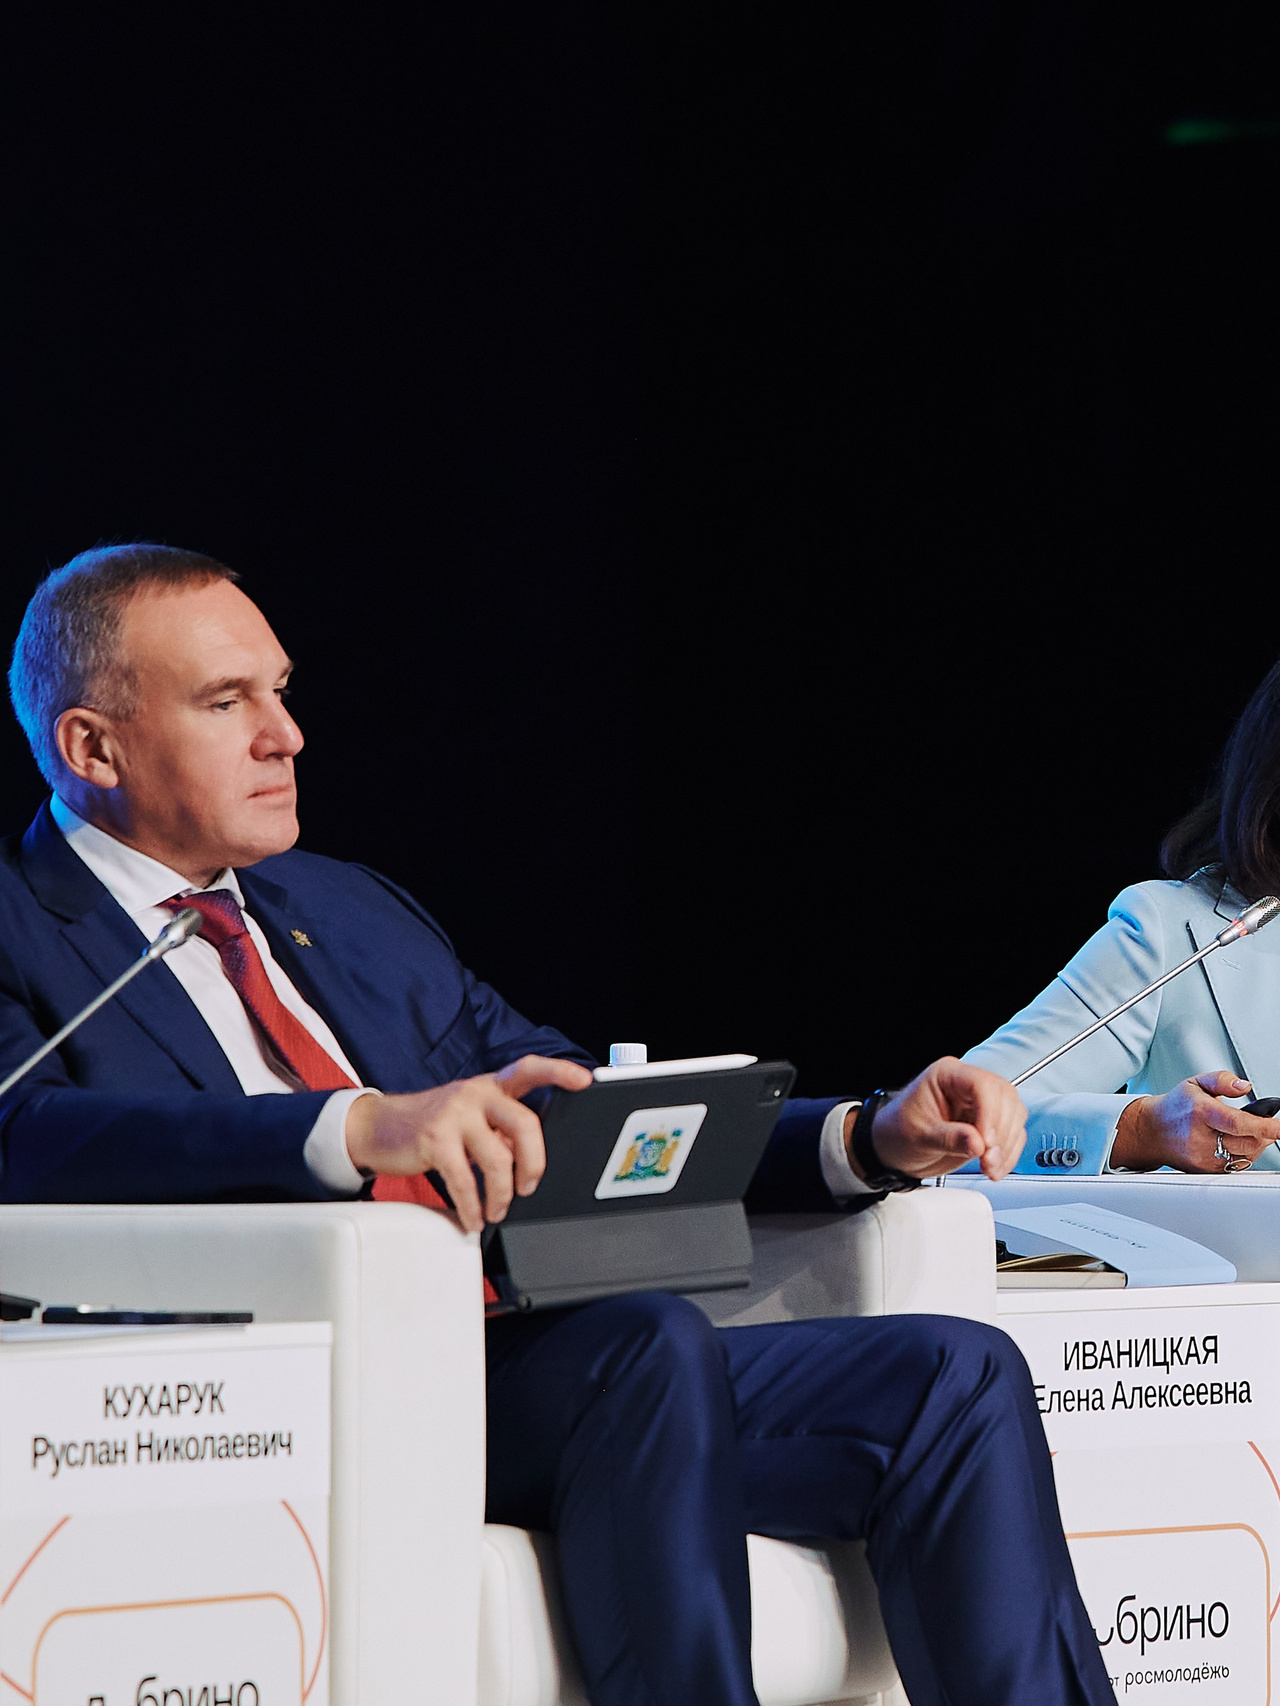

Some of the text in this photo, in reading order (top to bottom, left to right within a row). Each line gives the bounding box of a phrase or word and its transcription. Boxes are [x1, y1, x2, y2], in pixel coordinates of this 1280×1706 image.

[1063, 1335, 1219, 1374] ИВАНИЦКАЯ
[104, 1381, 225, 1418] КУХАРУК
[1111, 1379, 1253, 1410] Алексеевна
[32, 1431, 292, 1478] Руслан Николаевич
[1096, 1595, 1229, 1656] обрино
[1125, 1663, 1230, 1693] росмолодёжь
